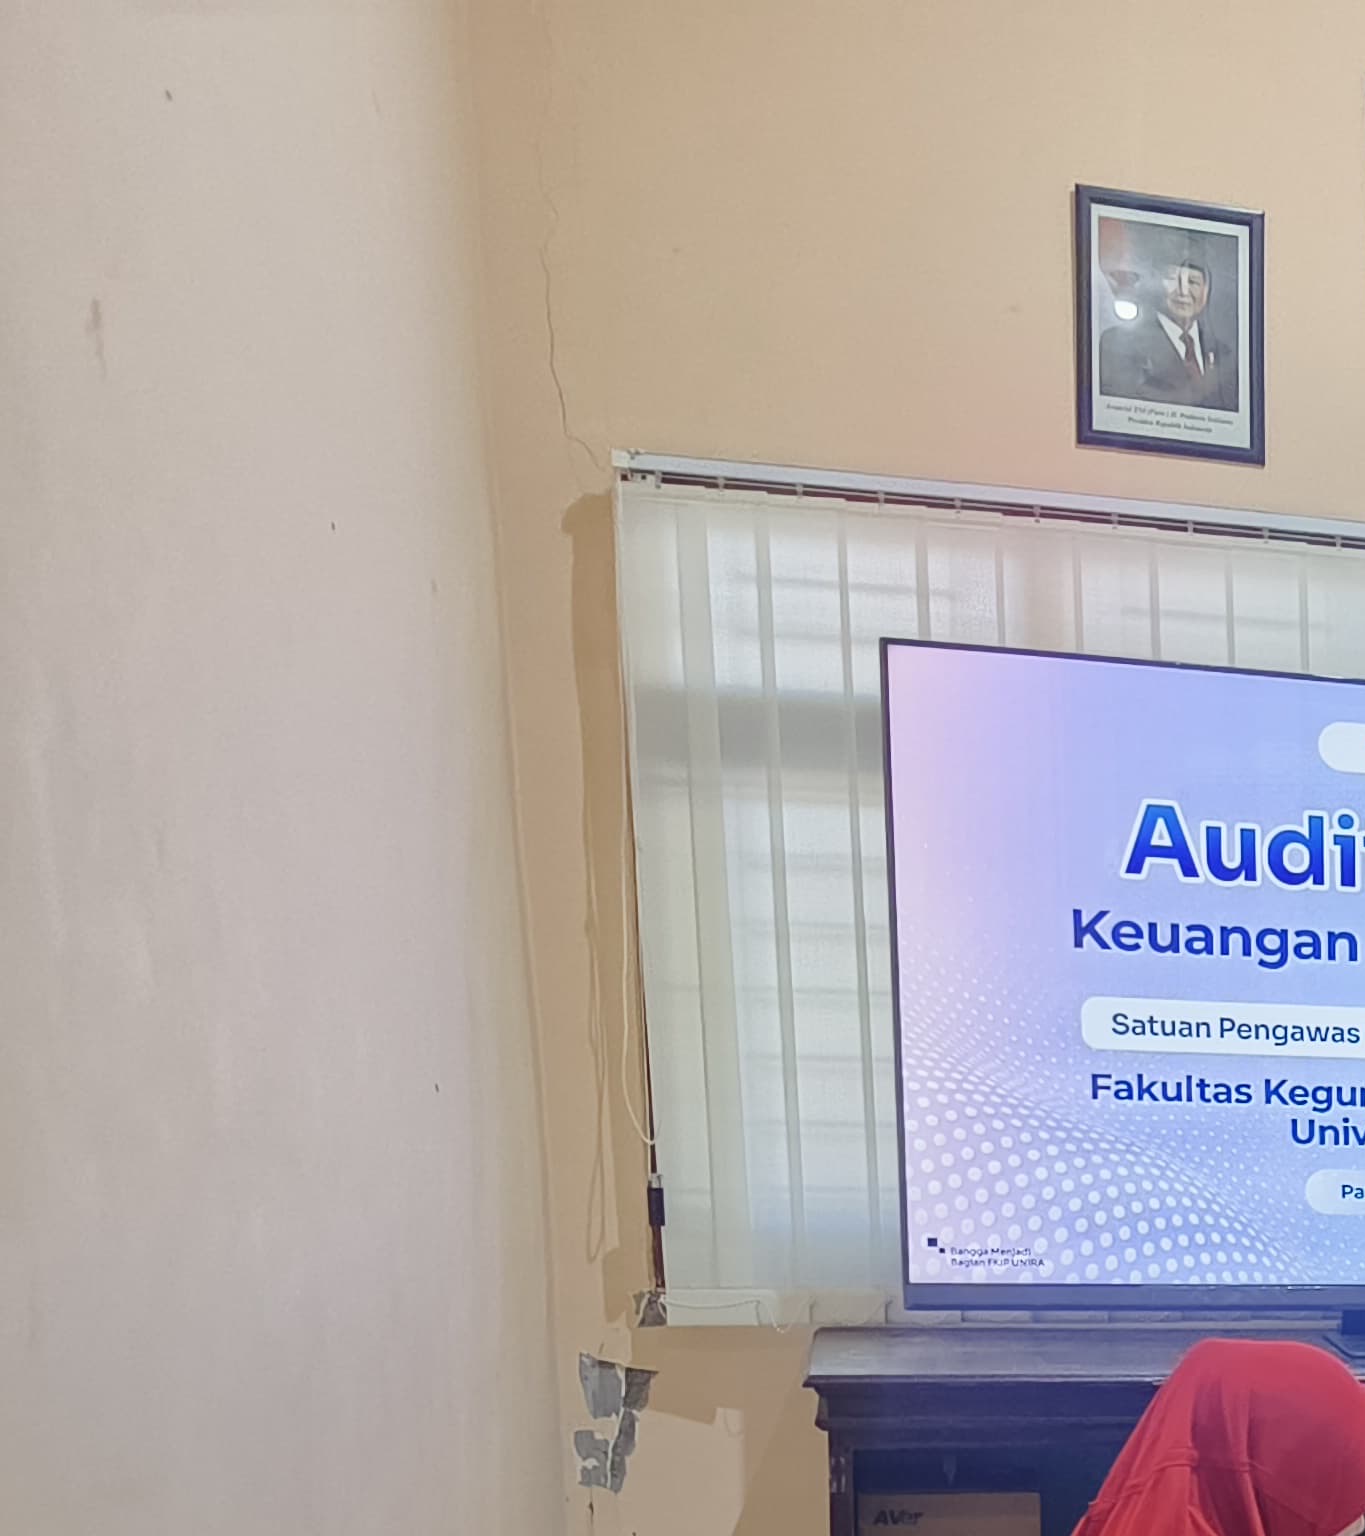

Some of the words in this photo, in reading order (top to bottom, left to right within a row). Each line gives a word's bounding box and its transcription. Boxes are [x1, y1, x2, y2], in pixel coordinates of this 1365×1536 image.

[1071, 907, 1359, 970] Keuangan
[1110, 1012, 1212, 1039] Satuan
[1218, 1017, 1361, 1047] Pengawas
[1090, 1072, 1253, 1105] Fakultas
